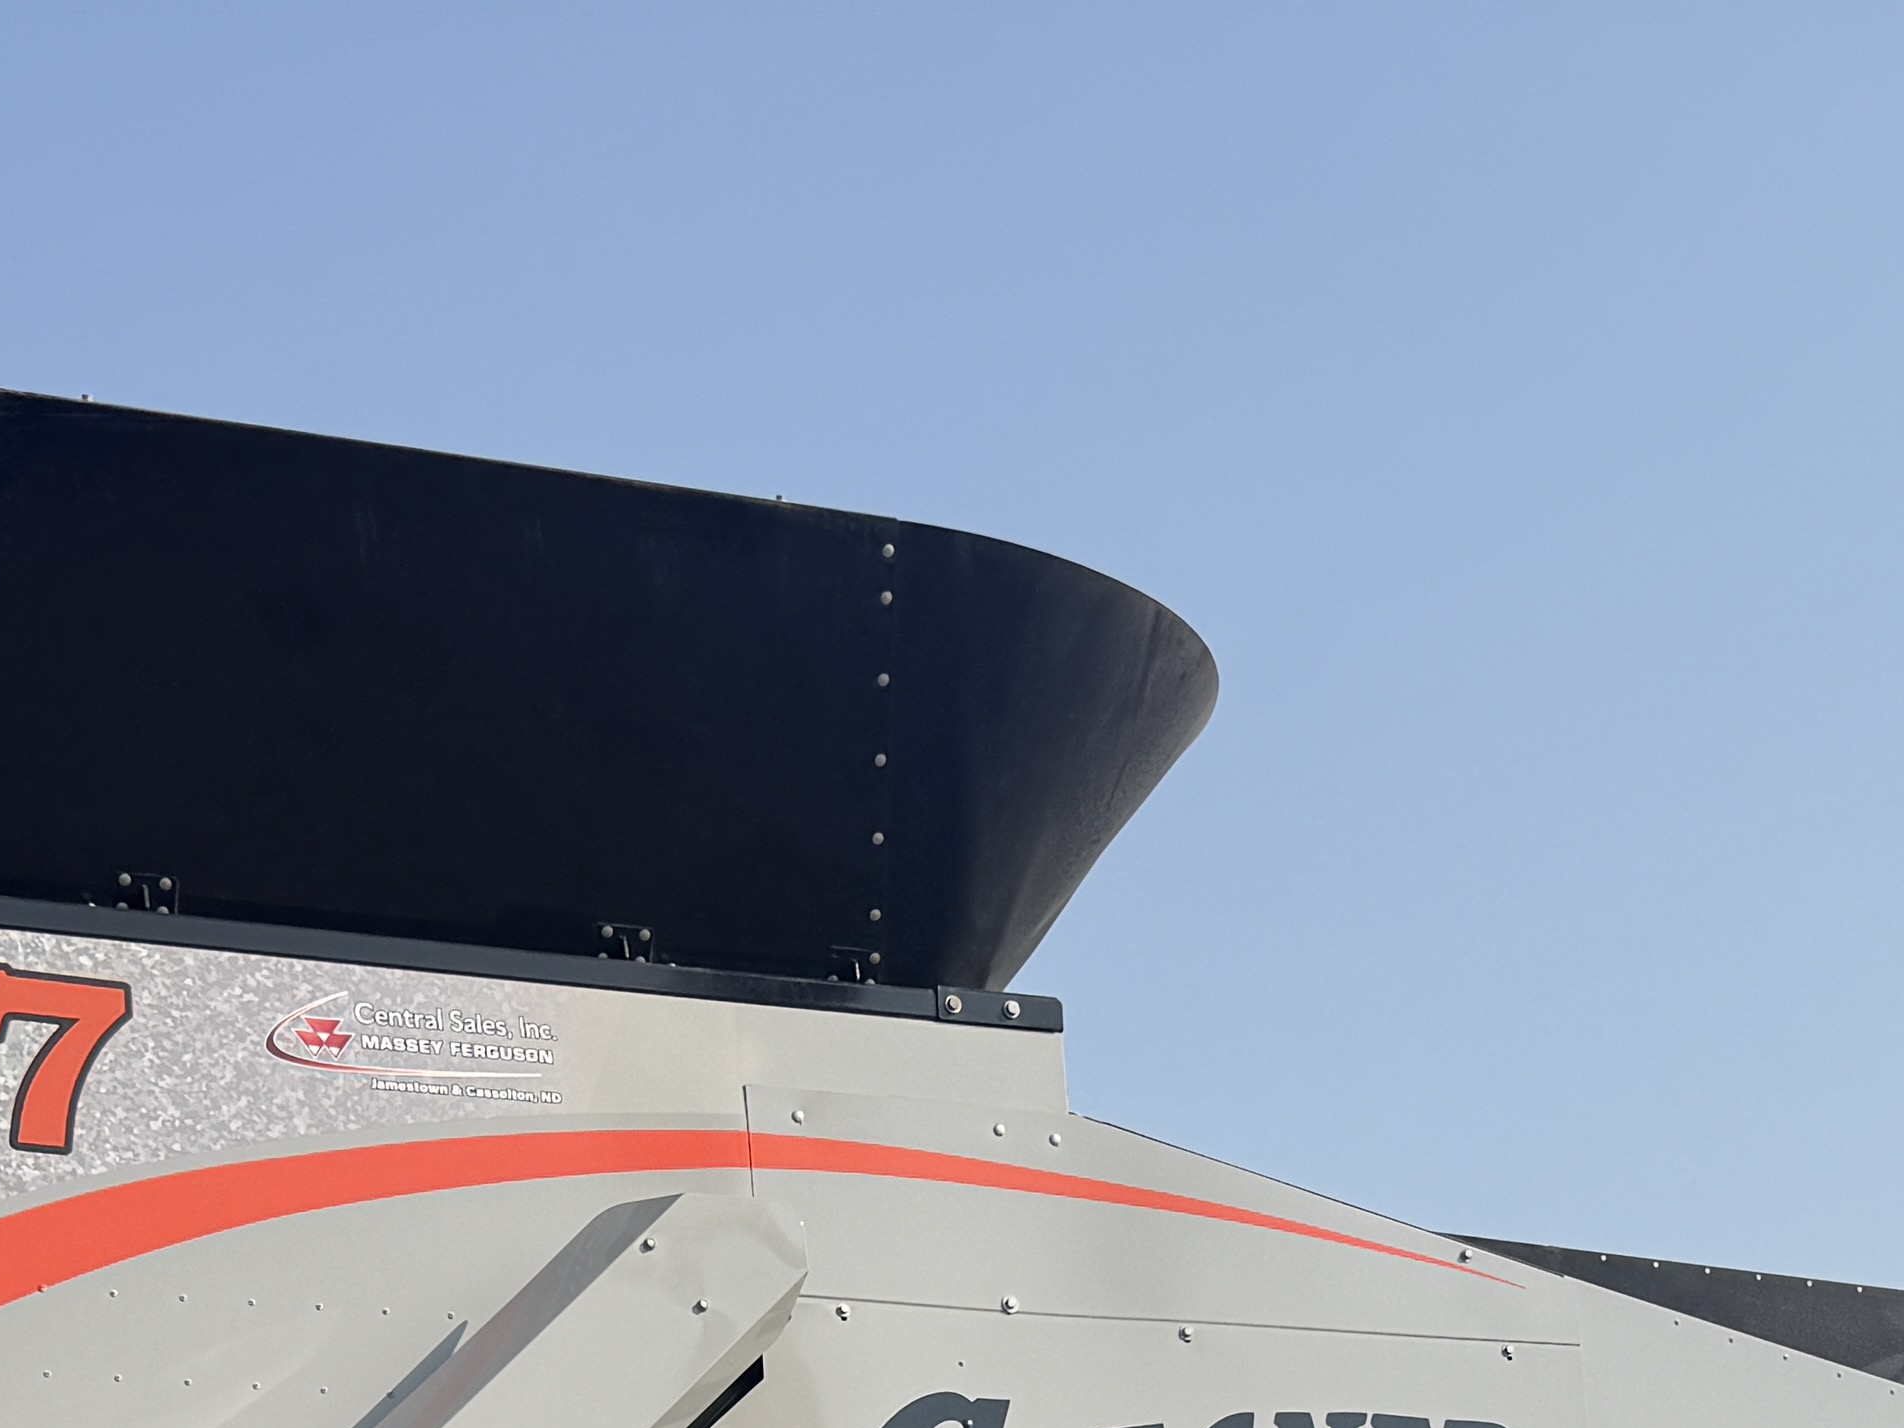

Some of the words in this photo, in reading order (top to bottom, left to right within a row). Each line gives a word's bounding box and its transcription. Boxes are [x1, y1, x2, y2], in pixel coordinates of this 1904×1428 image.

[353, 1001, 444, 1031] Central
[449, 1009, 513, 1040] Sales,
[519, 1016, 558, 1041] Inc.
[361, 1034, 443, 1055] MASSEY
[450, 1041, 554, 1065] FERGUSON
[371, 1078, 448, 1096] Jamestown
[452, 1085, 462, 1096] &
[541, 1091, 562, 1104] ND
